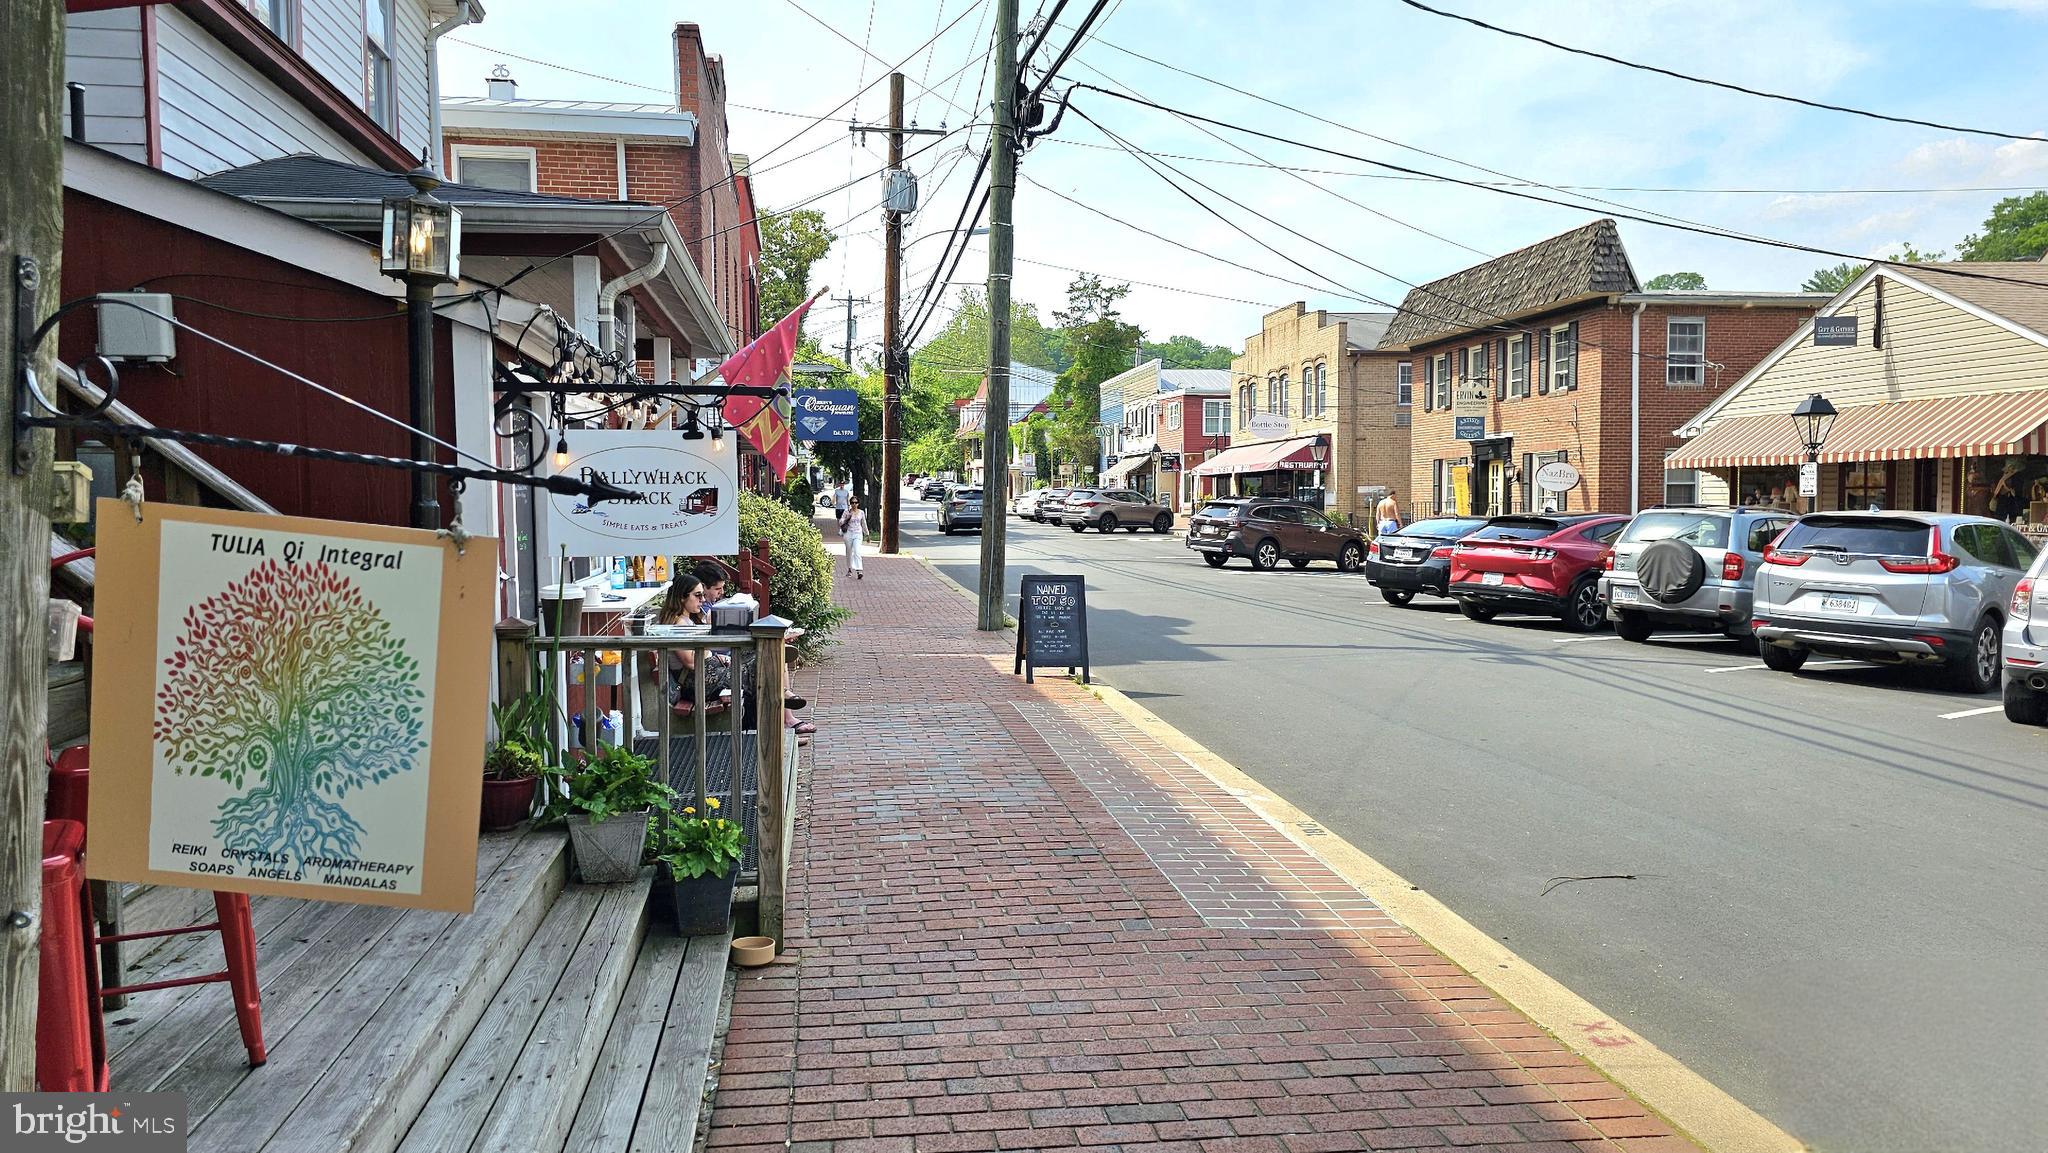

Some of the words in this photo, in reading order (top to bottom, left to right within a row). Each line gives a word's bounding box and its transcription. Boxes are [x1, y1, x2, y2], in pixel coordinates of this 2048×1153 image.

[797, 395, 856, 415] Occoquan
[580, 466, 708, 485] BALLYWHACK
[602, 519, 628, 530] SIMPLE
[661, 519, 688, 531] TREATS
[211, 533, 265, 556] TULIA
[283, 541, 304, 564] Qi
[320, 545, 404, 571] Integral
[171, 843, 207, 857] REIKI
[221, 848, 289, 864] CRYSTALS
[303, 856, 414, 876] AROMATHERAPY
[189, 861, 235, 875] SOAPS
[248, 867, 302, 881] ANGELS
[323, 873, 398, 890] MANDALAS
